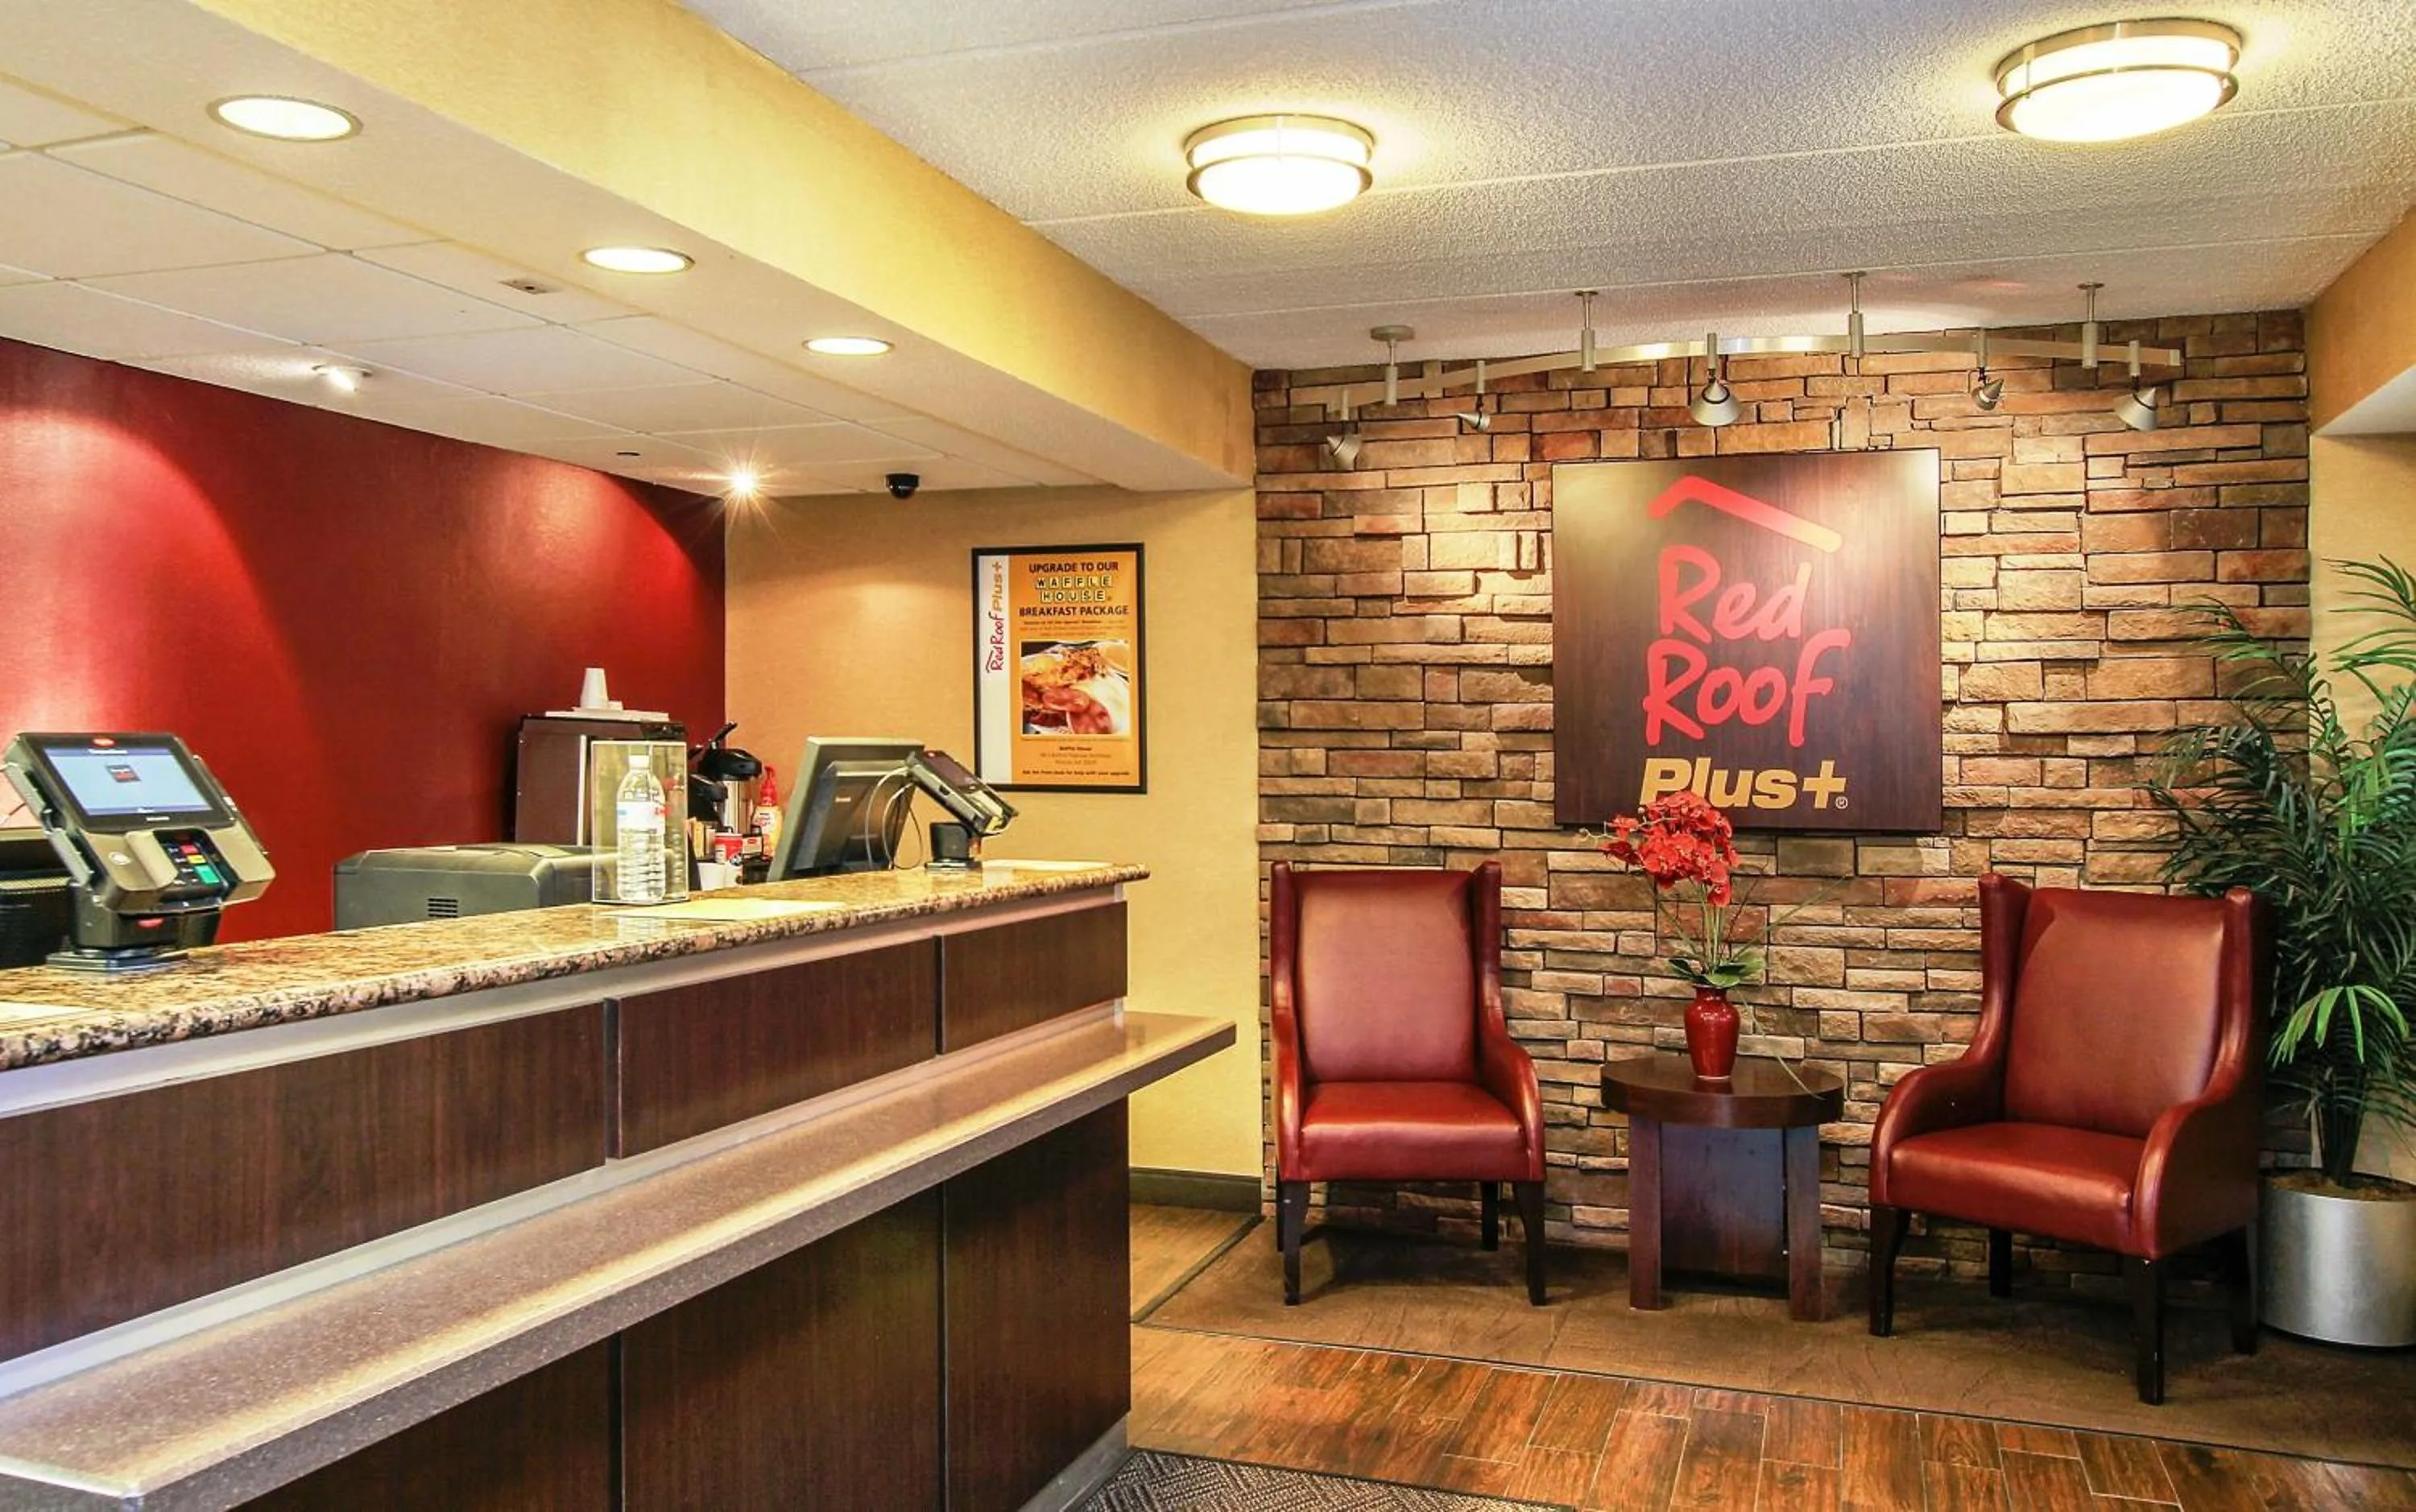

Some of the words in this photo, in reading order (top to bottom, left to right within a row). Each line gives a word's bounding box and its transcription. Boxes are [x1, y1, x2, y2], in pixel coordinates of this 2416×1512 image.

[1028, 563, 1077, 574] UPGRADE
[1081, 562, 1094, 572] TO
[1096, 561, 1119, 572] OUR
[1036, 576, 1111, 588] WAFFLE
[1042, 589, 1106, 602] HOUSE
[1657, 543, 1813, 643] Red
[1019, 606, 1077, 617] BREAKFAST
[1080, 605, 1129, 616] PACKAGE
[989, 611, 1004, 645] Roof
[1642, 628, 1851, 747] Roof
